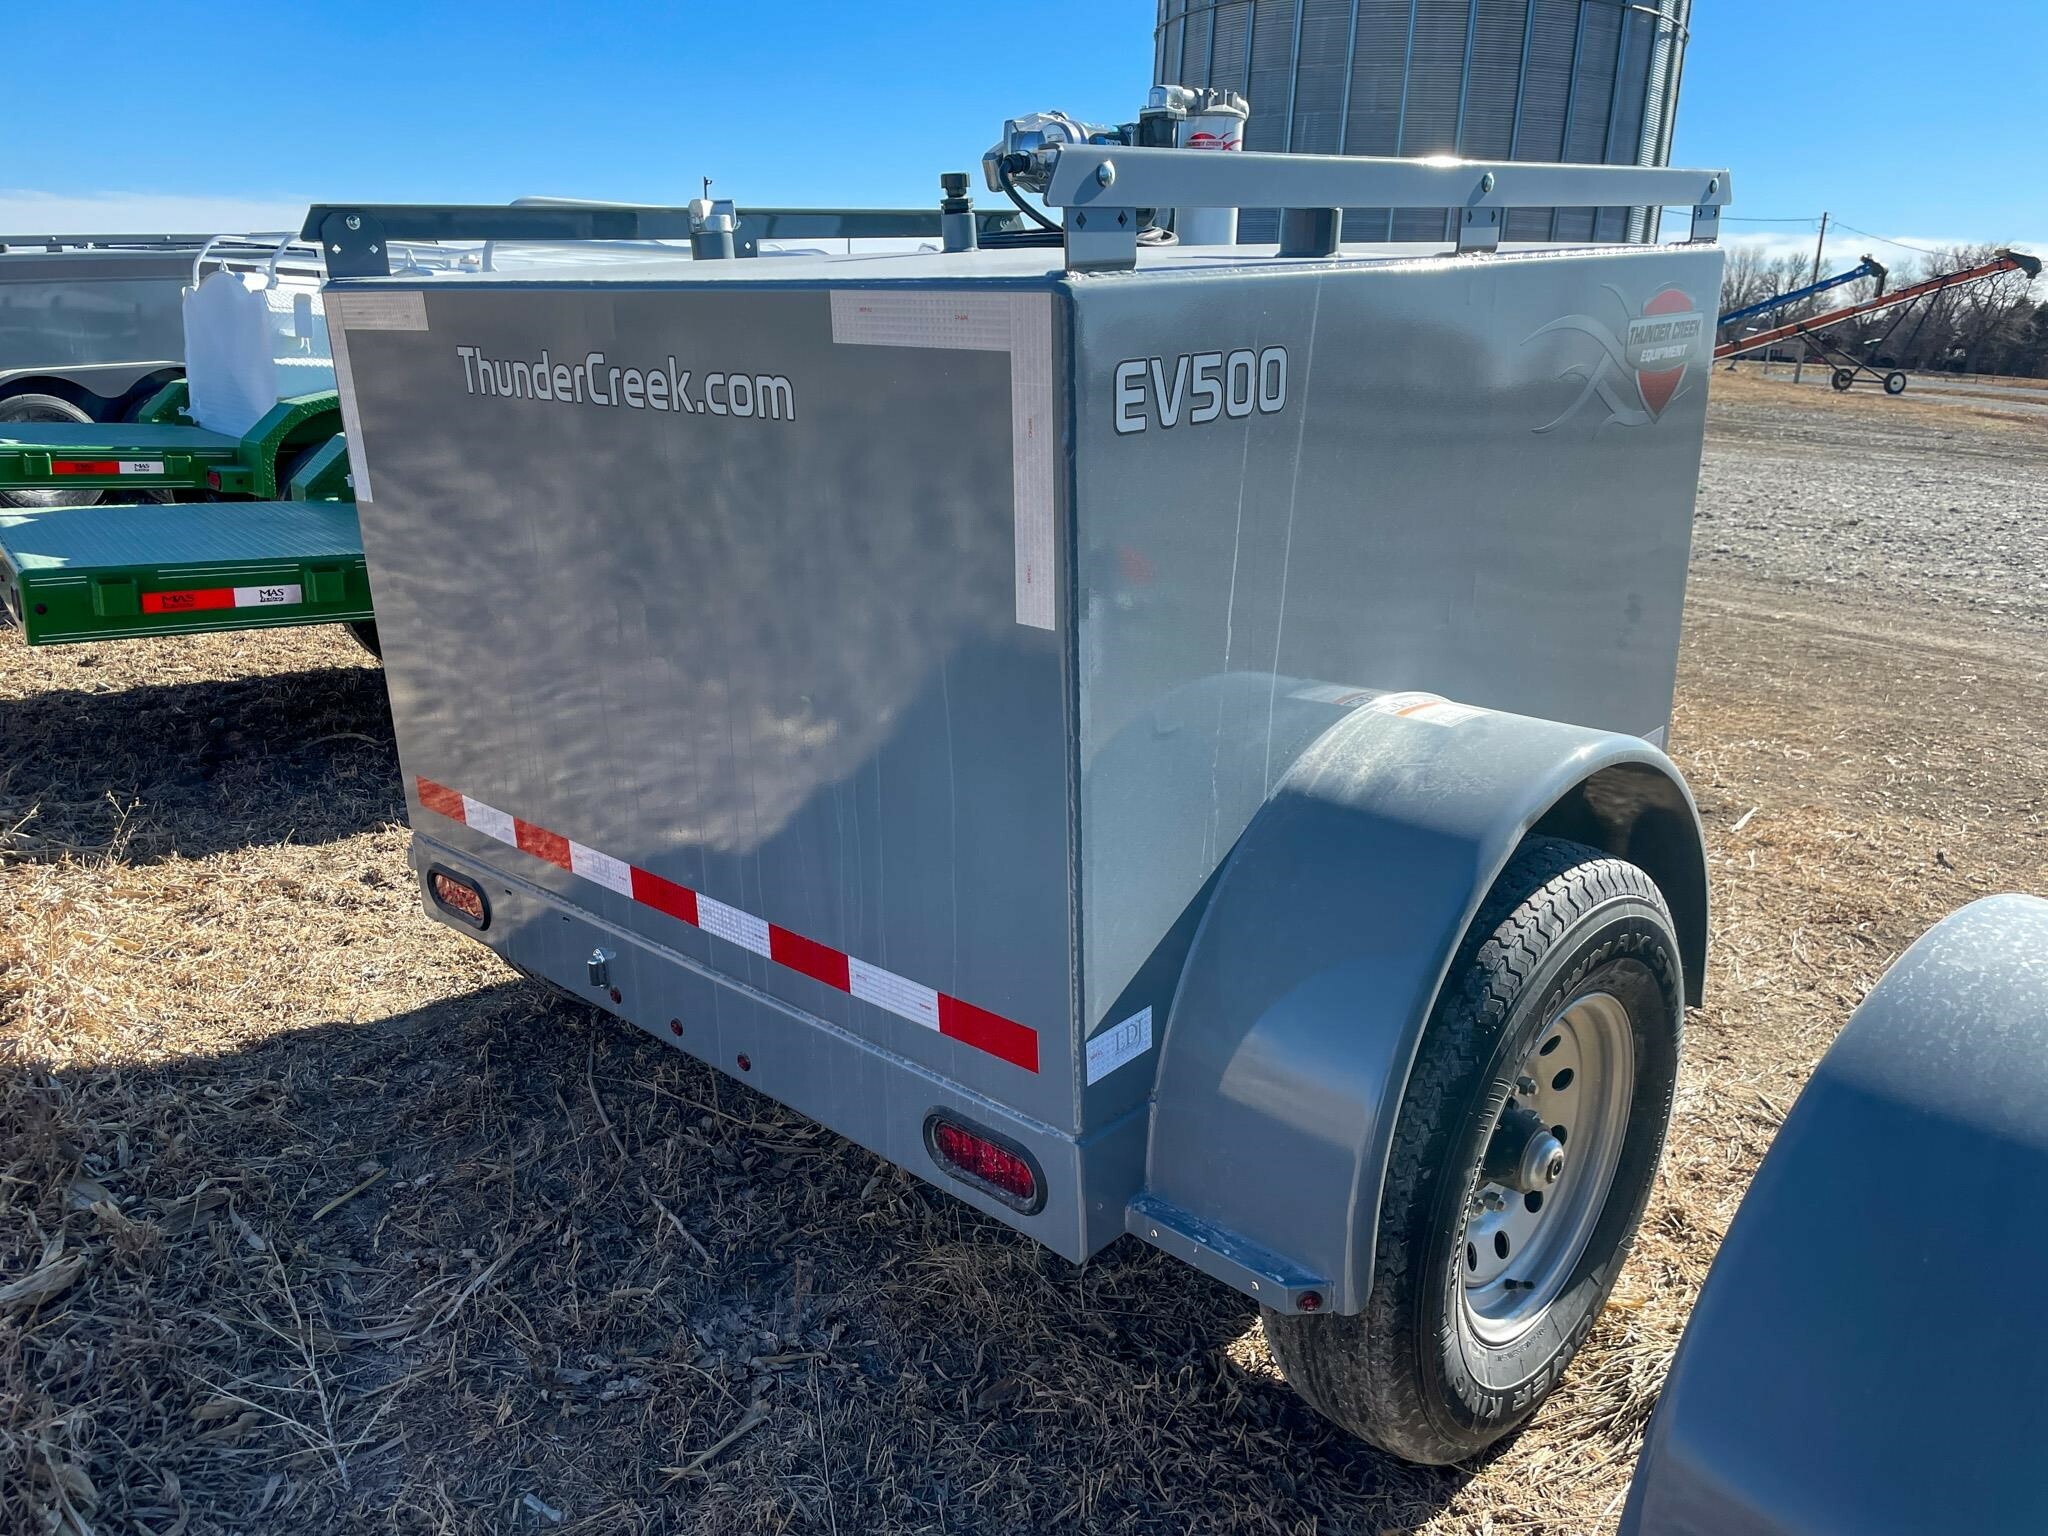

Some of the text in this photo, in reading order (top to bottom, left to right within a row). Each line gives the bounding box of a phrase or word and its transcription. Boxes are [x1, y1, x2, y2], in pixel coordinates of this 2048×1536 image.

[1630, 320, 1702, 344] THUNDER CREEK
[1640, 344, 1687, 362] EQUIPMENT
[456, 345, 797, 421] ThunderCreek.com
[1113, 344, 1289, 437] EV500
[161, 594, 196, 602] MAS
[258, 588, 284, 597] MAS
[1454, 1374, 1504, 1419] KING
